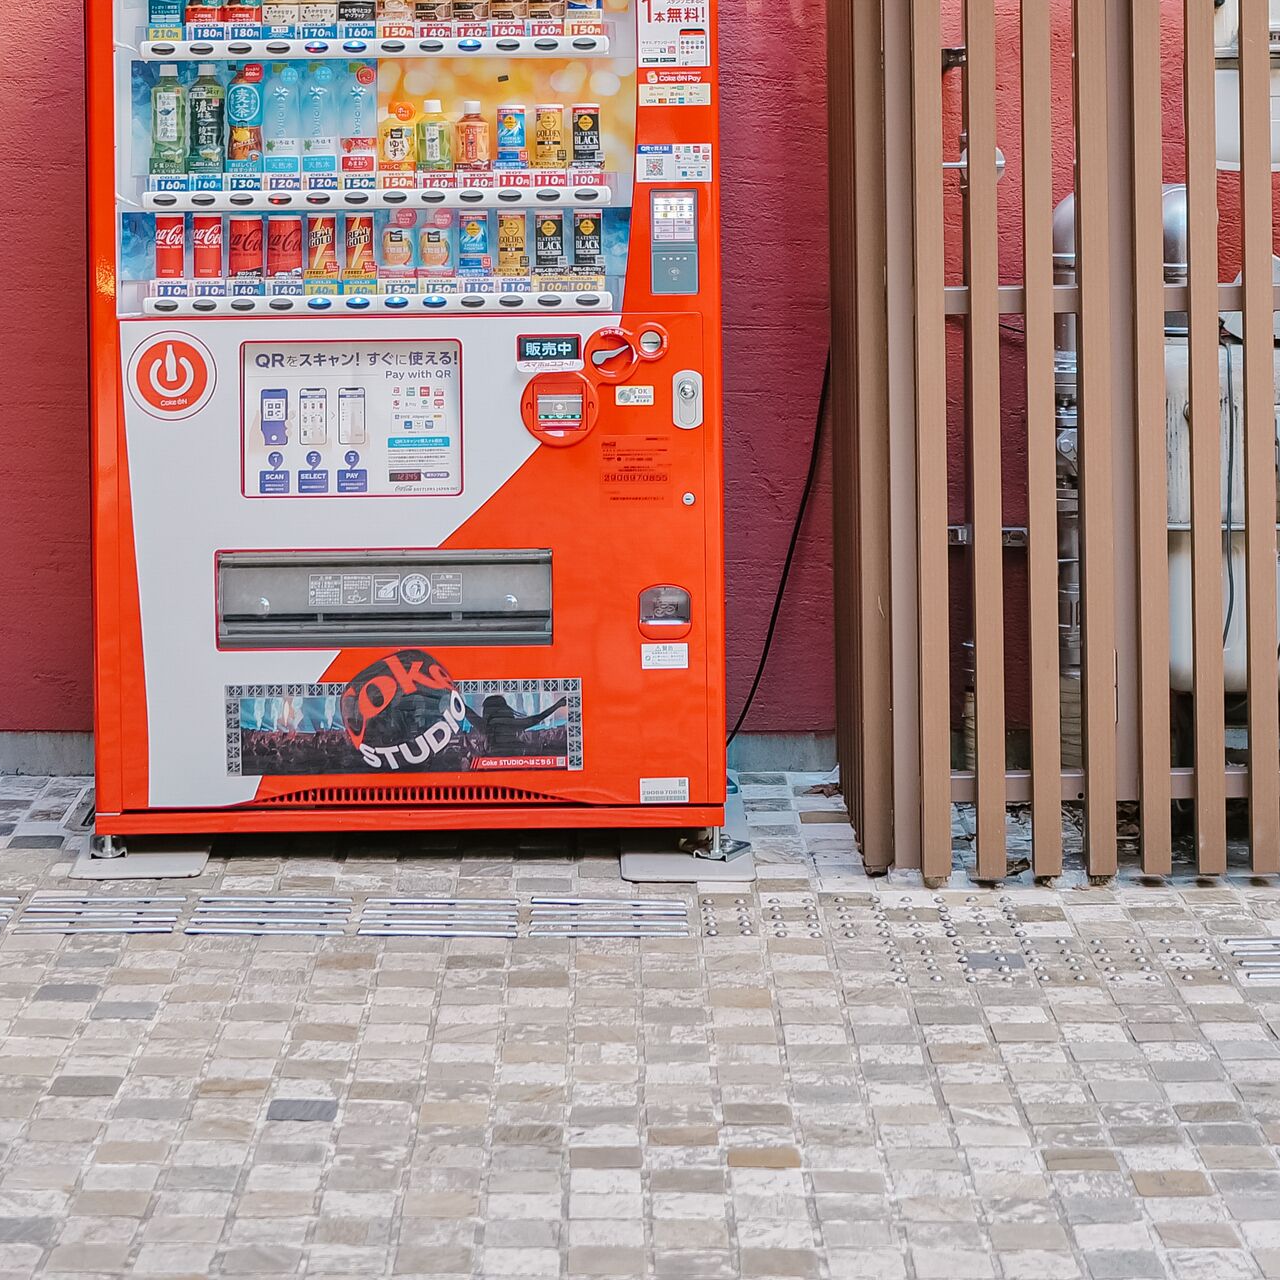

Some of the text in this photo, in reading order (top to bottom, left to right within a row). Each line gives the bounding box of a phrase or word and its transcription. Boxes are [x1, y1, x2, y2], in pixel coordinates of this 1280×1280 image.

[197, 29, 222, 38] 180円
[234, 29, 259, 37] 180円
[348, 28, 373, 37] 160円
[384, 28, 413, 37] 150円
[422, 28, 450, 37] 140円
[494, 26, 521, 35] 160円
[534, 26, 561, 35] 160円
[573, 26, 600, 34] 150円
[234, 88, 250, 118] 麦茶
[574, 136, 598, 145] BLACK
[390, 140, 399, 158] ゆず
[308, 161, 330, 169] 天然水
[232, 180, 260, 188] 130円
[271, 179, 299, 188] 120円
[310, 179, 337, 187] 120円
[346, 179, 375, 188] 150円
[384, 177, 412, 187] 150円
[502, 176, 529, 185] 110円
[537, 176, 564, 185] 110円
[575, 175, 600, 184] 100円
[161, 181, 185, 190] 160円
[310, 226, 333, 238] REAL
[347, 226, 371, 239] REAL
[310, 235, 332, 248] GOLD
[348, 235, 370, 248] GOLD
[537, 241, 562, 250] BLACK
[575, 240, 600, 249] BLACK
[160, 286, 187, 295] 110円
[197, 286, 225, 295] 110円
[275, 286, 302, 295] 140円
[310, 286, 335, 295] 140円
[348, 286, 373, 295] 140円
[387, 285, 416, 294] 150円
[428, 285, 456, 293] 150円
[502, 283, 531, 292] 110円
[541, 283, 568, 291] 100円
[570, 282, 597, 291] 100円
[526, 342, 571, 356] 販売中
[255, 351, 458, 369] QRをスキャン! すぐに使える!
[385, 369, 451, 380] Pay with QR
[359, 690, 466, 770] STUDIO
